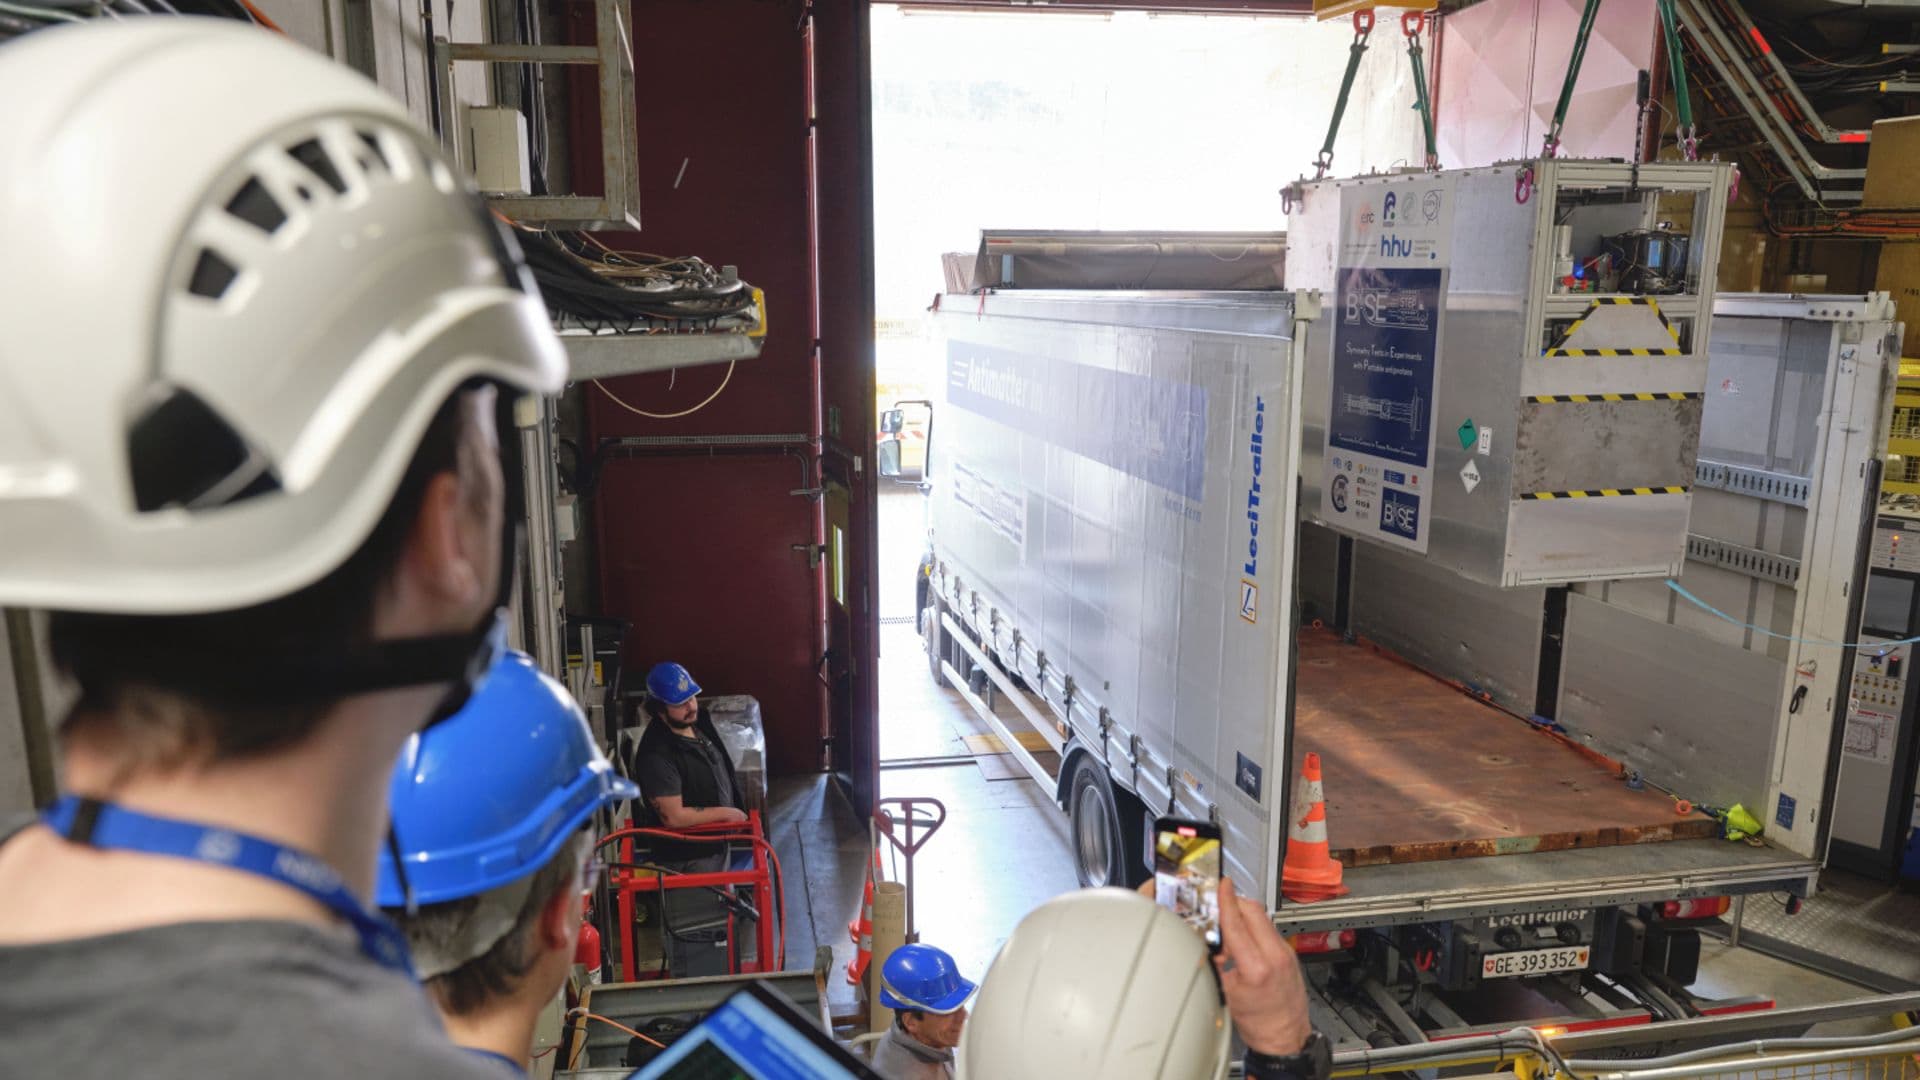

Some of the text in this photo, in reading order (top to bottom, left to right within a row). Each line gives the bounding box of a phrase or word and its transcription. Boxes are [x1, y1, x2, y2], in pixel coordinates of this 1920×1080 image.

[1361, 212, 1375, 223] erc
[1381, 234, 1412, 257] hhu
[1399, 297, 1416, 308] STEP
[1345, 341, 1370, 356] Symmetry
[1390, 346, 1422, 361] Experiments
[1353, 361, 1362, 370] with
[1363, 359, 1384, 373] Portable
[967, 355, 1025, 410] Antimatter
[1245, 396, 1265, 576] LeciTrailer
